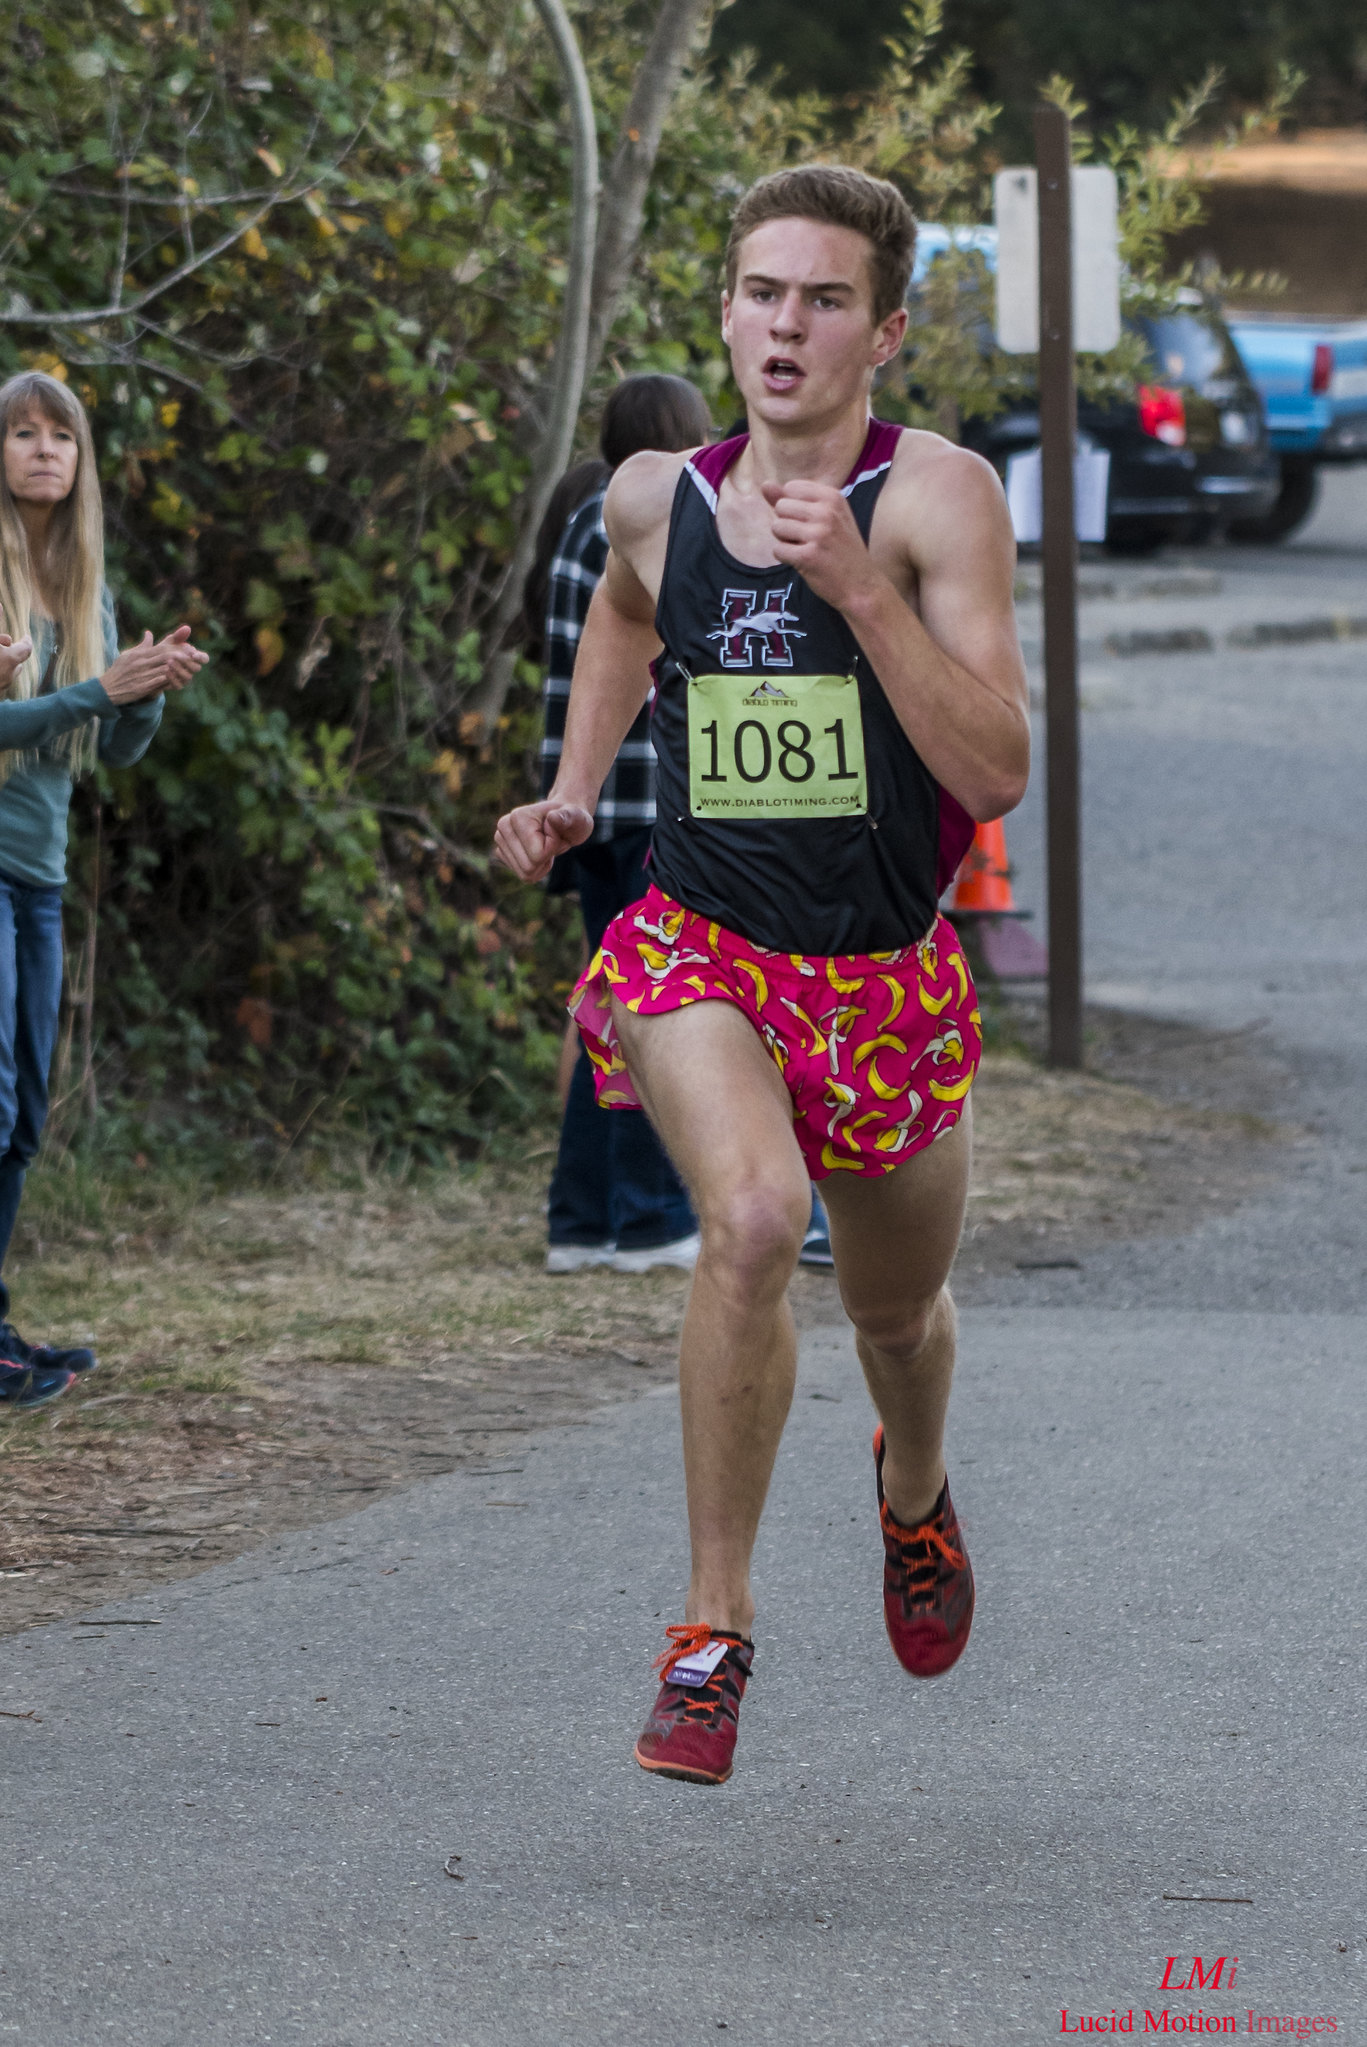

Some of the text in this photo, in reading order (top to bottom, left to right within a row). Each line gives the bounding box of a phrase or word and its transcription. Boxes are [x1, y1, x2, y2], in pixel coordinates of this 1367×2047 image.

[720, 589, 793, 667] H
[701, 718, 859, 783] 1081
[700, 796, 860, 807] WWW.DIABLOTIMING.COM
